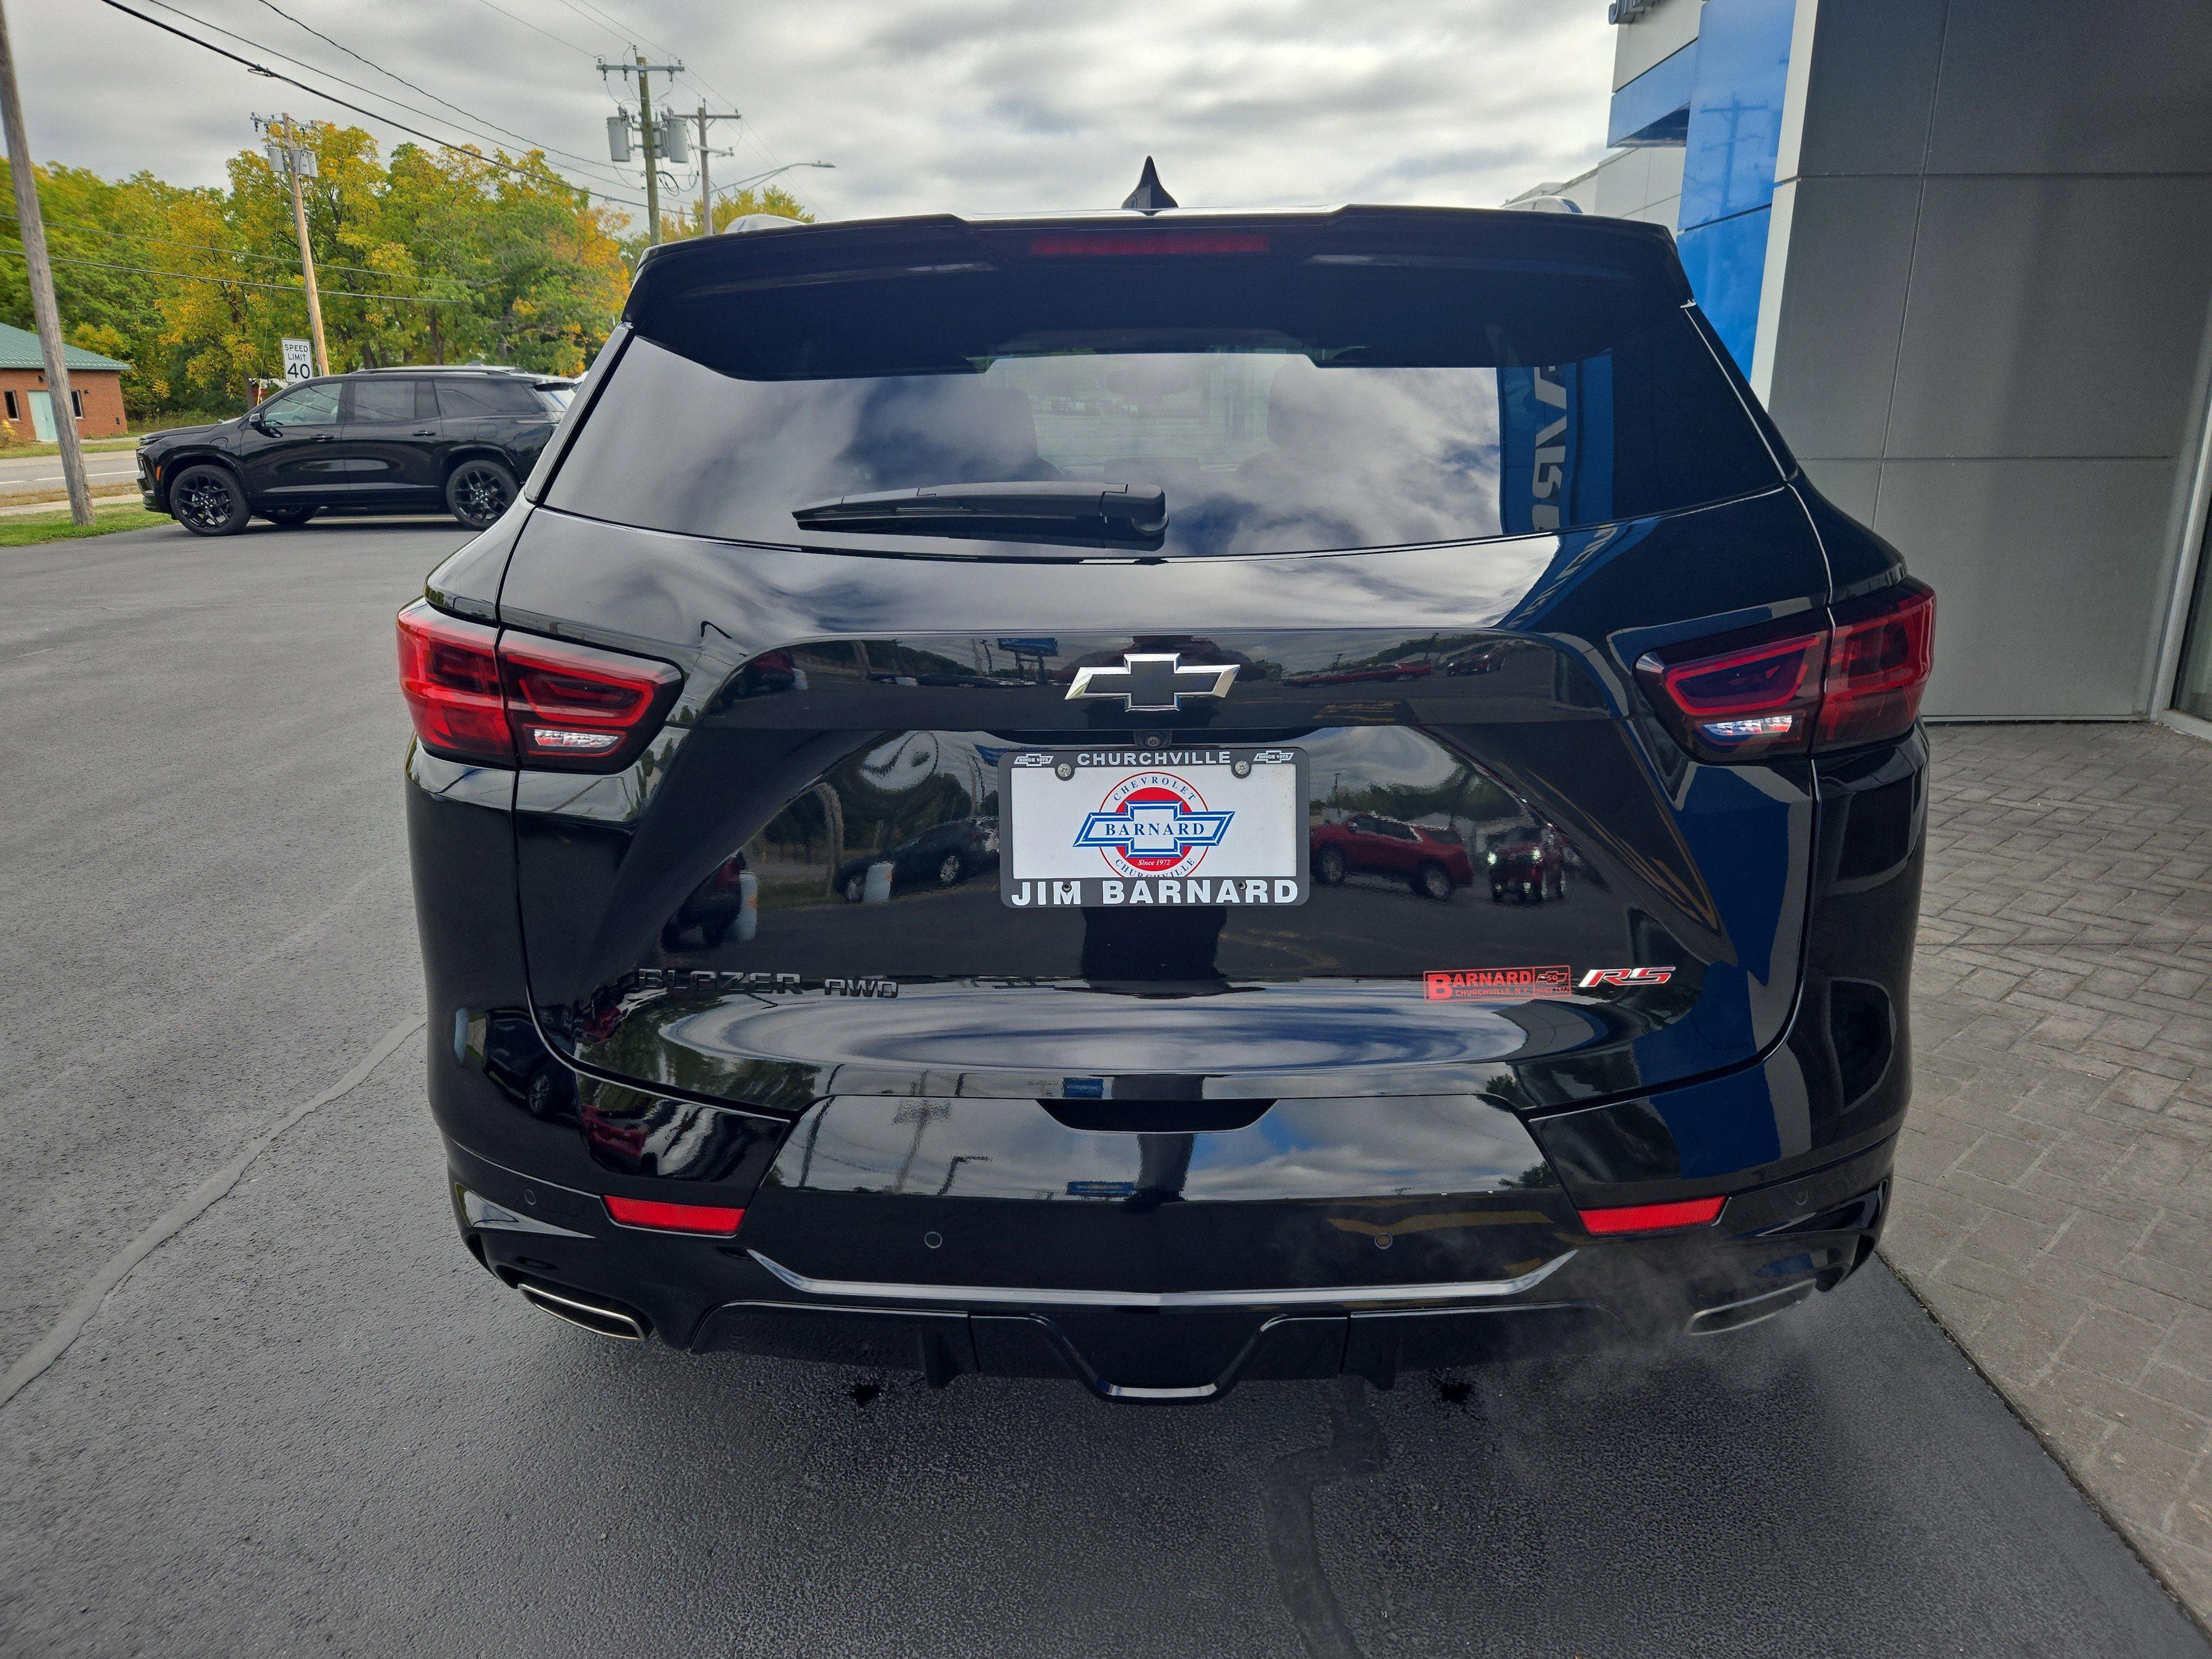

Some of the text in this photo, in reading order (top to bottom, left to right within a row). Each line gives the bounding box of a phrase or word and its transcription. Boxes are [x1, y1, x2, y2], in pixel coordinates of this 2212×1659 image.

[284, 344, 308, 352] SPEED
[288, 353, 306, 361] LIMIT
[287, 363, 310, 379] 40
[1077, 751, 1231, 766] CHURCHVILLE
[1113, 776, 1196, 801] CHEVROLET
[1104, 822, 1205, 836] BARNARD
[1011, 879, 1298, 906] JIM BARNARD
[639, 968, 898, 998] BLAZER AWD
[1427, 970, 1532, 999] BARNARD
[1578, 966, 1676, 988] RS
